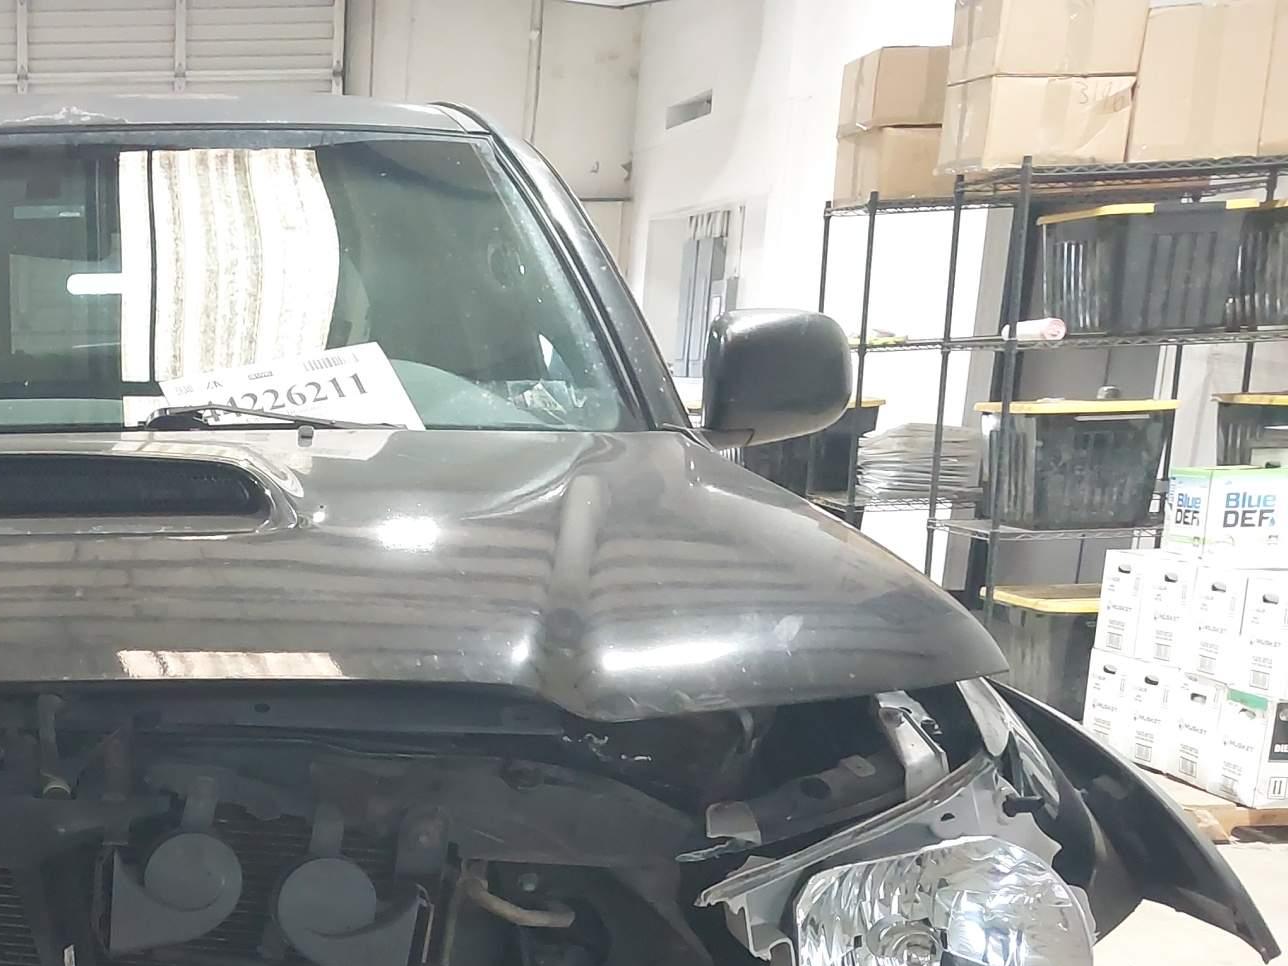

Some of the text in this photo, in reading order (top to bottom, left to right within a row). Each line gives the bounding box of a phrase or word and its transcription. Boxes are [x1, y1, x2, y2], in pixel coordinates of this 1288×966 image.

[1177, 493, 1202, 509] Blue
[1224, 492, 1277, 509] Blue
[1222, 509, 1275, 528] DEF
